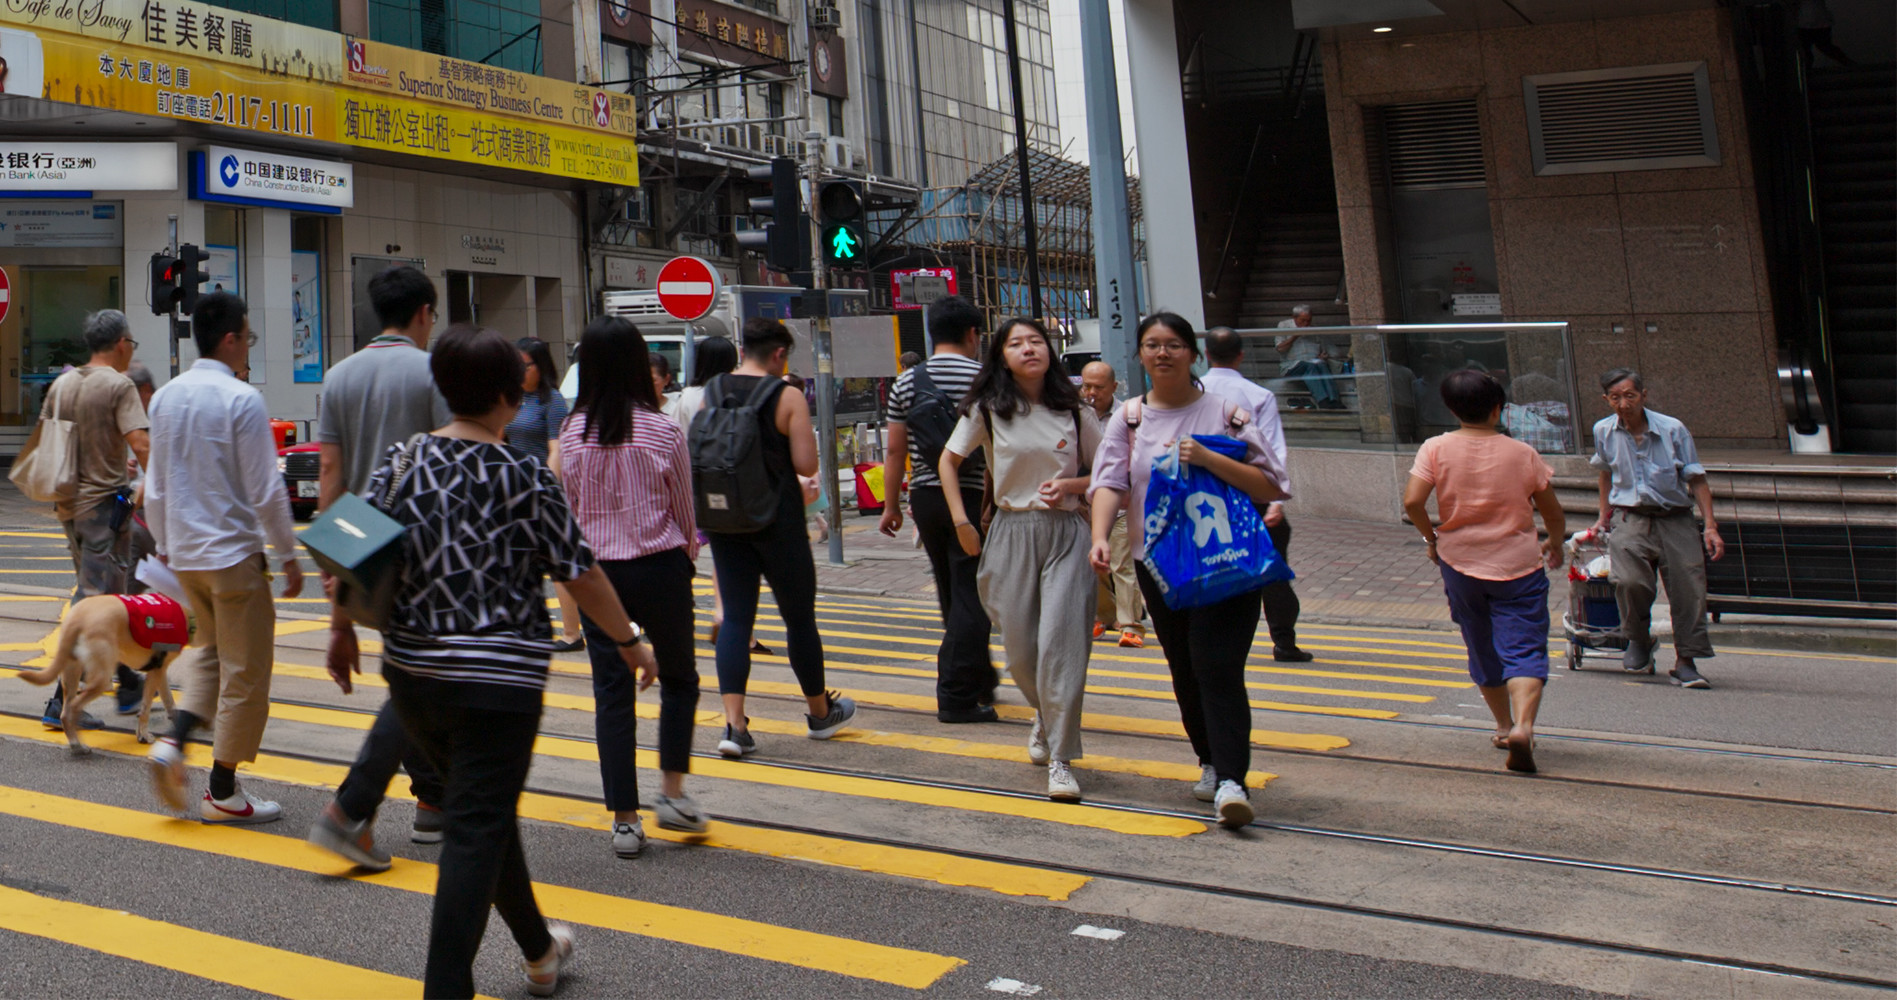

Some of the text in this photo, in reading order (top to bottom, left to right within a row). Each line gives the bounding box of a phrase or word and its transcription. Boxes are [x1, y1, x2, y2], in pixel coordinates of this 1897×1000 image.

[141, 0, 254, 60] 佳美餐廳
[99, 54, 190, 90] 本大廈地庫
[399, 71, 563, 119] Superior Strategy Business Centre
[571, 106, 595, 127] CTR
[611, 113, 634, 133] CWB
[554, 137, 633, 163] www.virtual.com.hk
[8, 169, 36, 180] Bank
[37, 169, 67, 181] (Asia)
[585, 159, 627, 180] 2287-5000
[244, 177, 332, 196] China Construction Bank (Asia)
